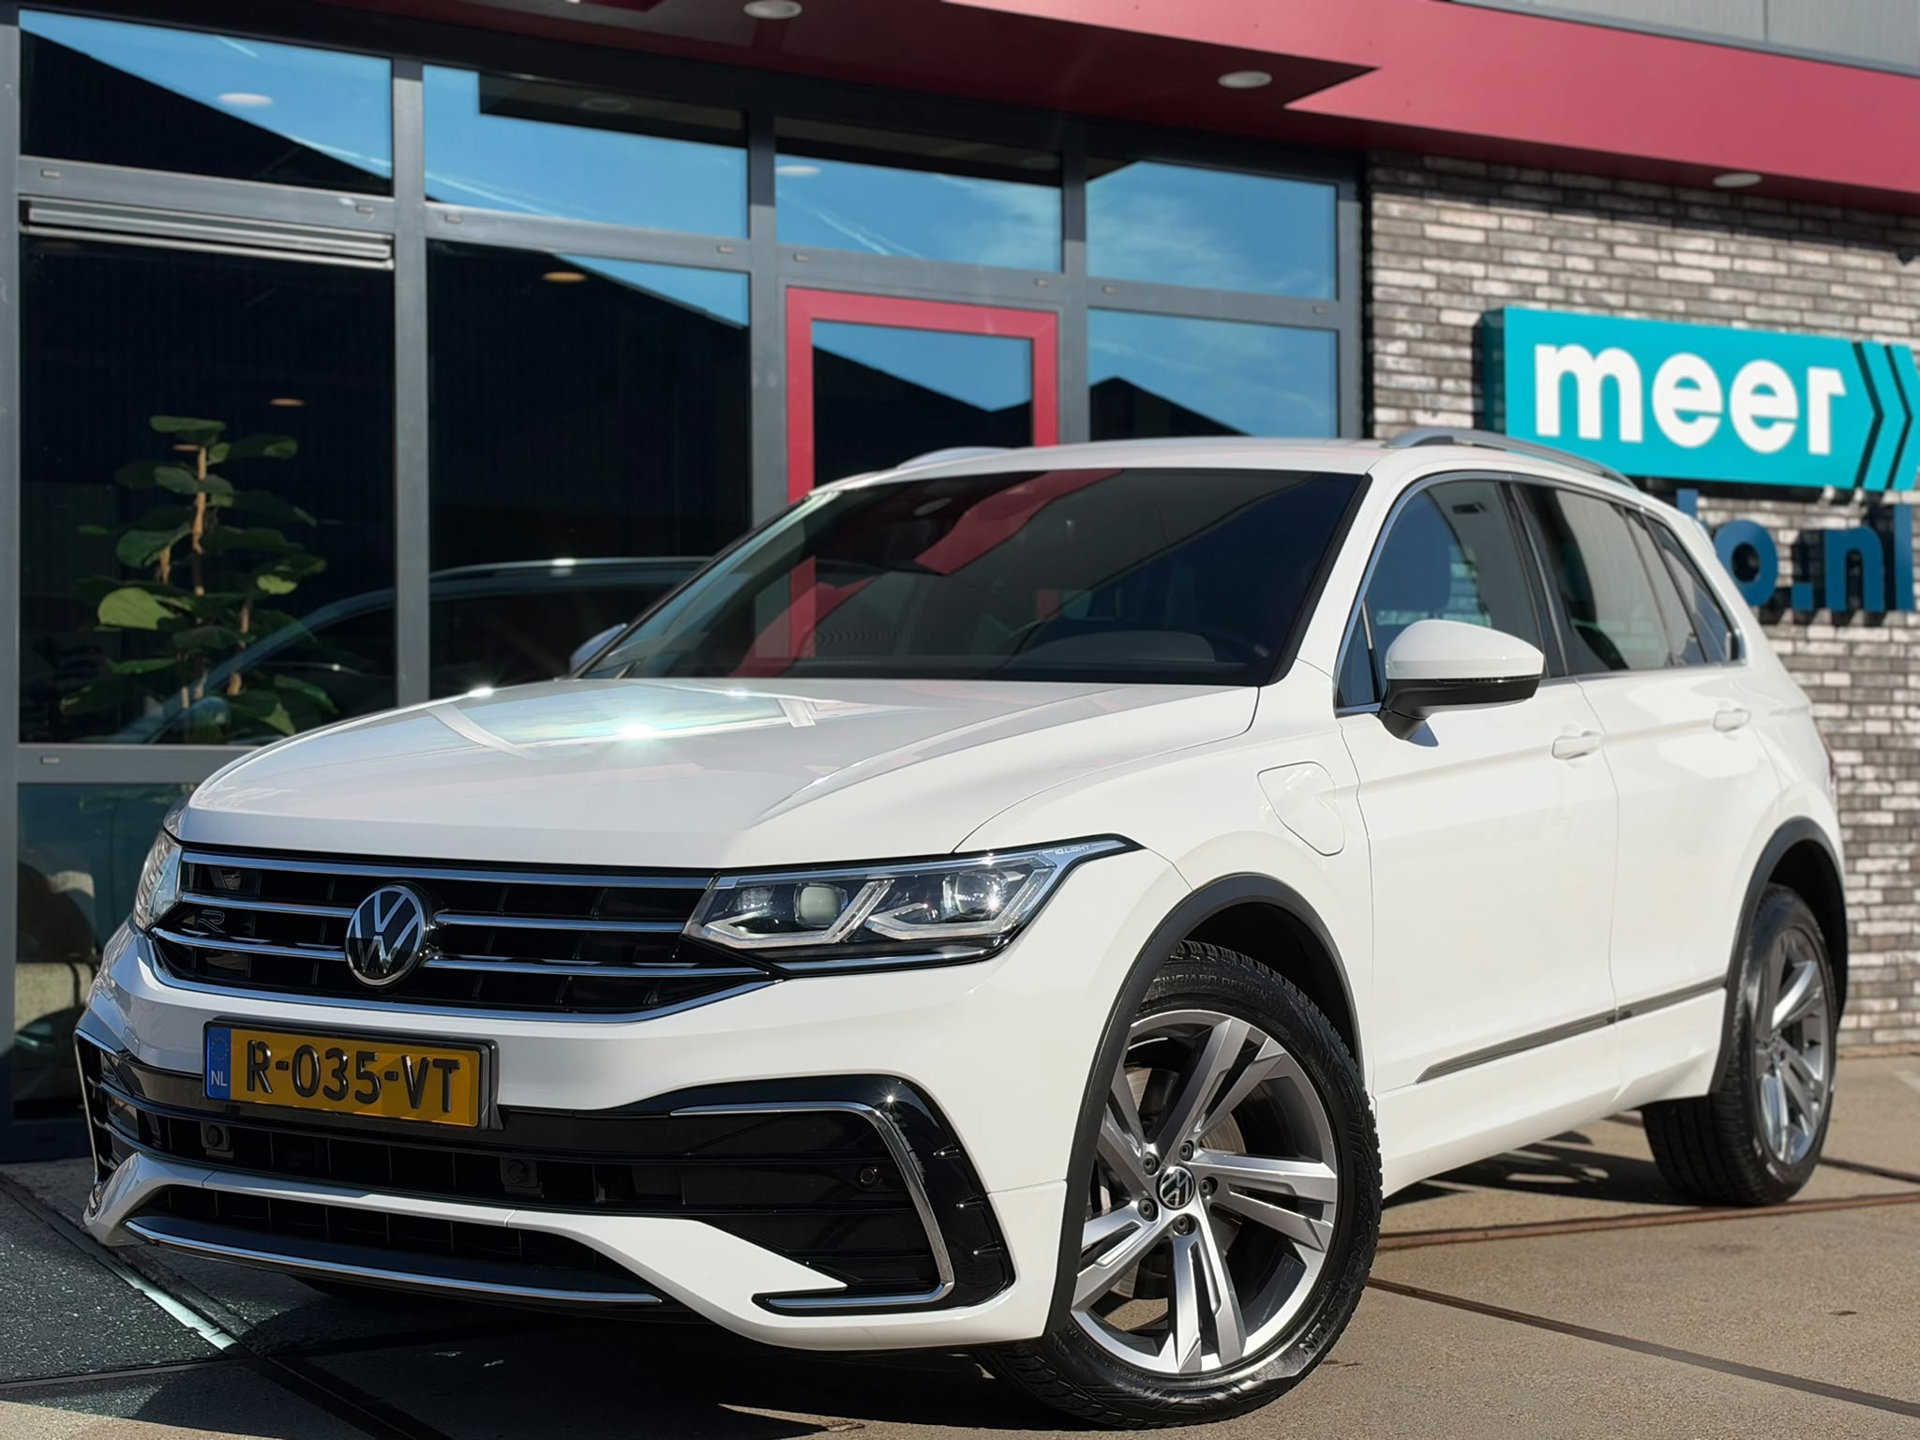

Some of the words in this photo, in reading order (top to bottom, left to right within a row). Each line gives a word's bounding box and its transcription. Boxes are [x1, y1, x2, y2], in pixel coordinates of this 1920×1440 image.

[1535, 344, 1847, 455] meer
[1677, 489, 1915, 613] o.nl
[211, 1069, 228, 1087] NL
[246, 1040, 461, 1114] R-035-VT
